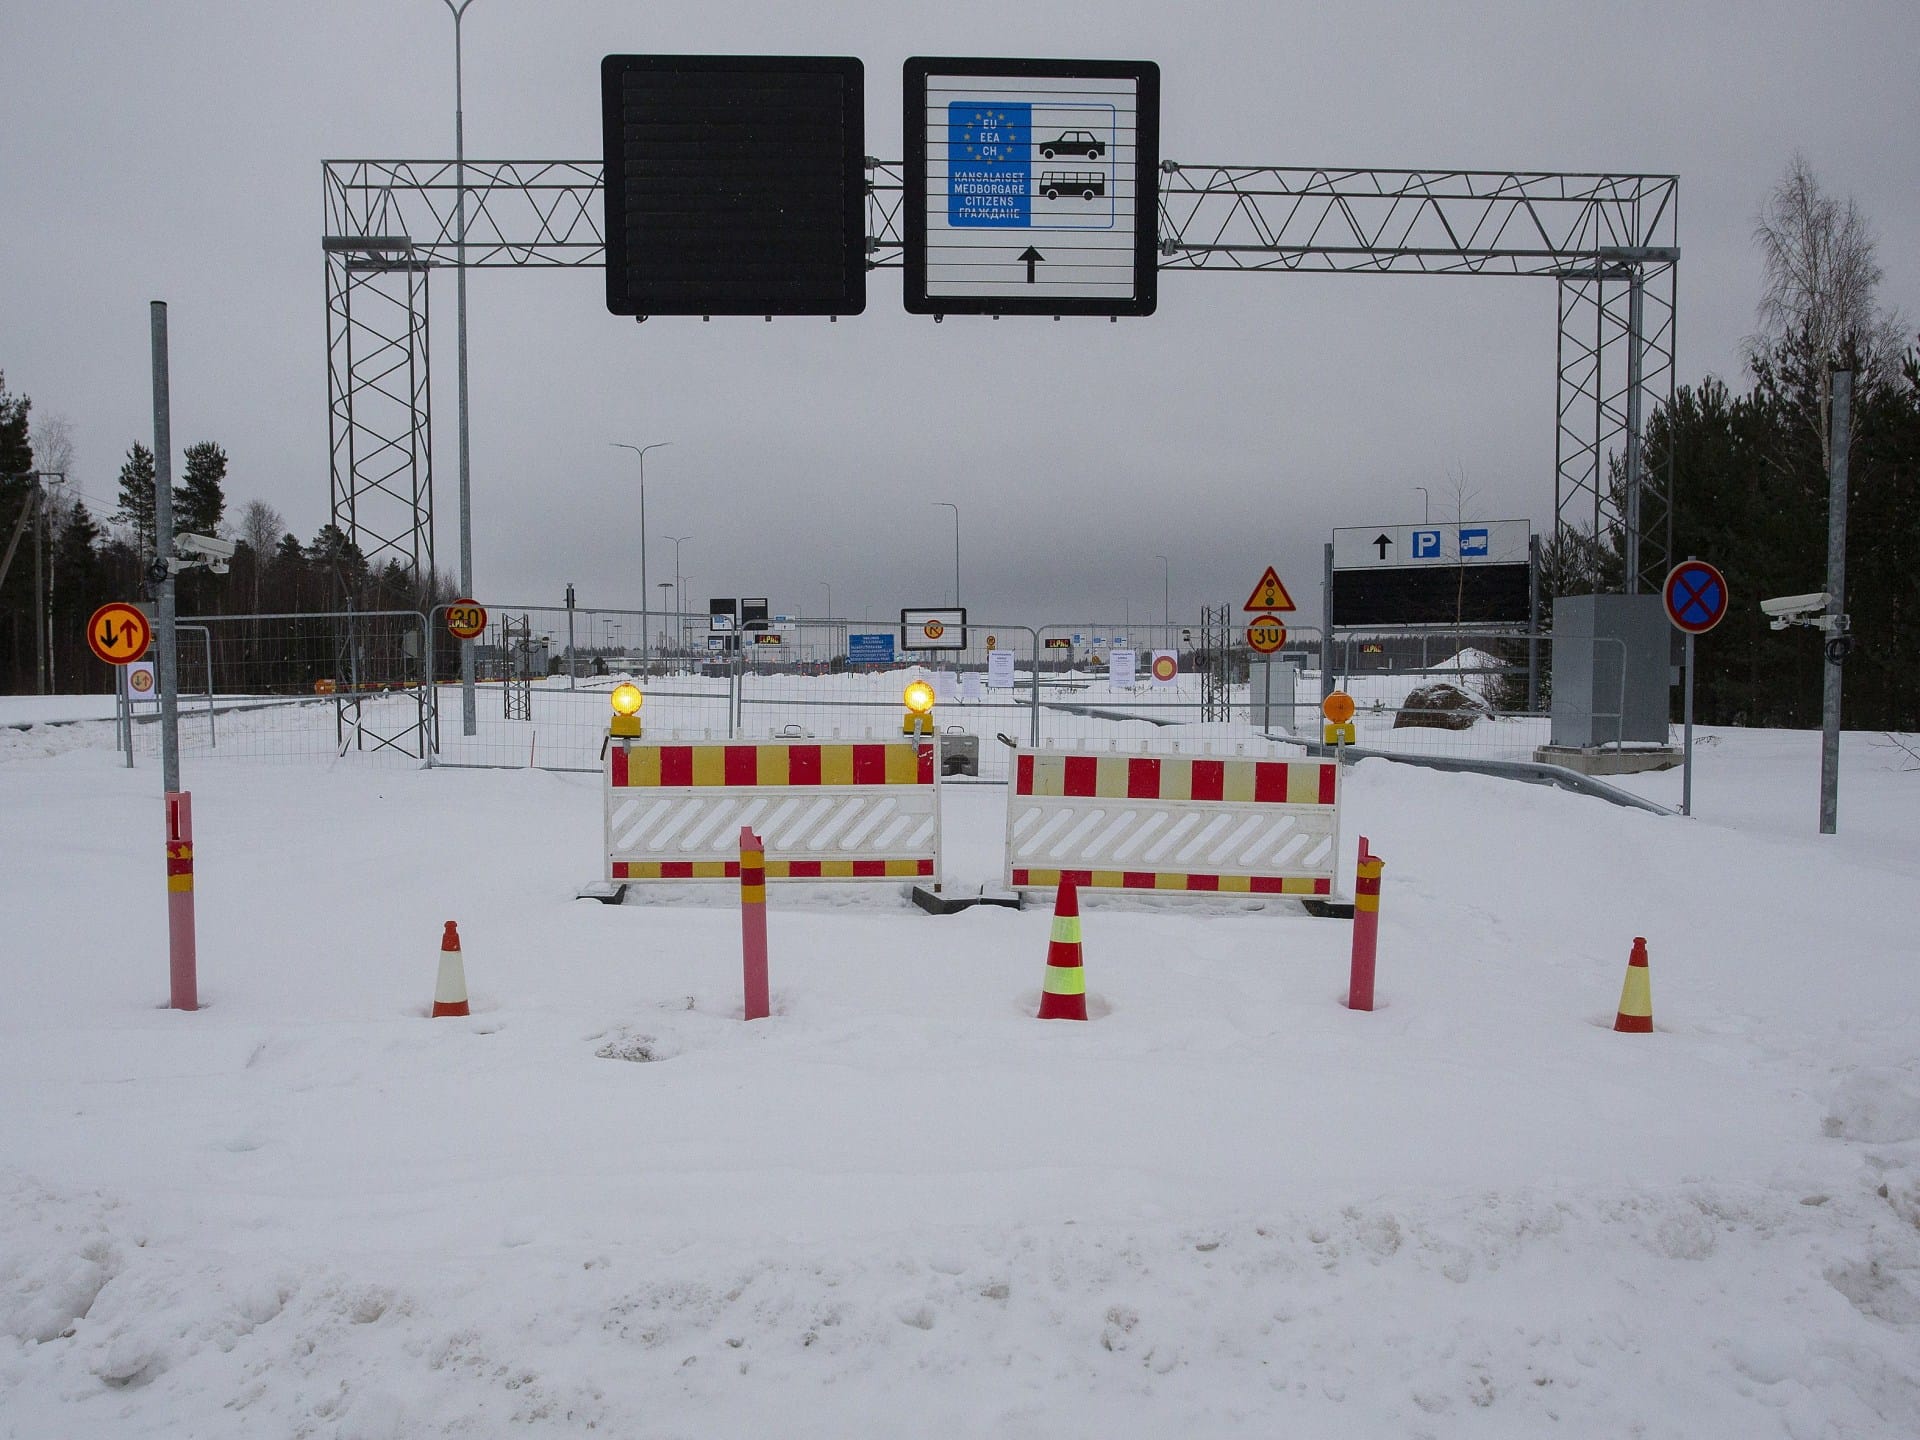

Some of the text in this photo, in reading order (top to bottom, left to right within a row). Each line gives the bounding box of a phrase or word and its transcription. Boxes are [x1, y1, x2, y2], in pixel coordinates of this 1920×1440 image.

[983, 119, 997, 129] EU
[980, 132, 1000, 143] EEA
[982, 146, 997, 156] CH
[954, 171, 1025, 183] KANSALAISET
[954, 183, 1025, 194] MEDBORGARE
[965, 196, 1014, 206] CITIZENS
[1418, 533, 1437, 557] P
[1254, 624, 1279, 645] 30
